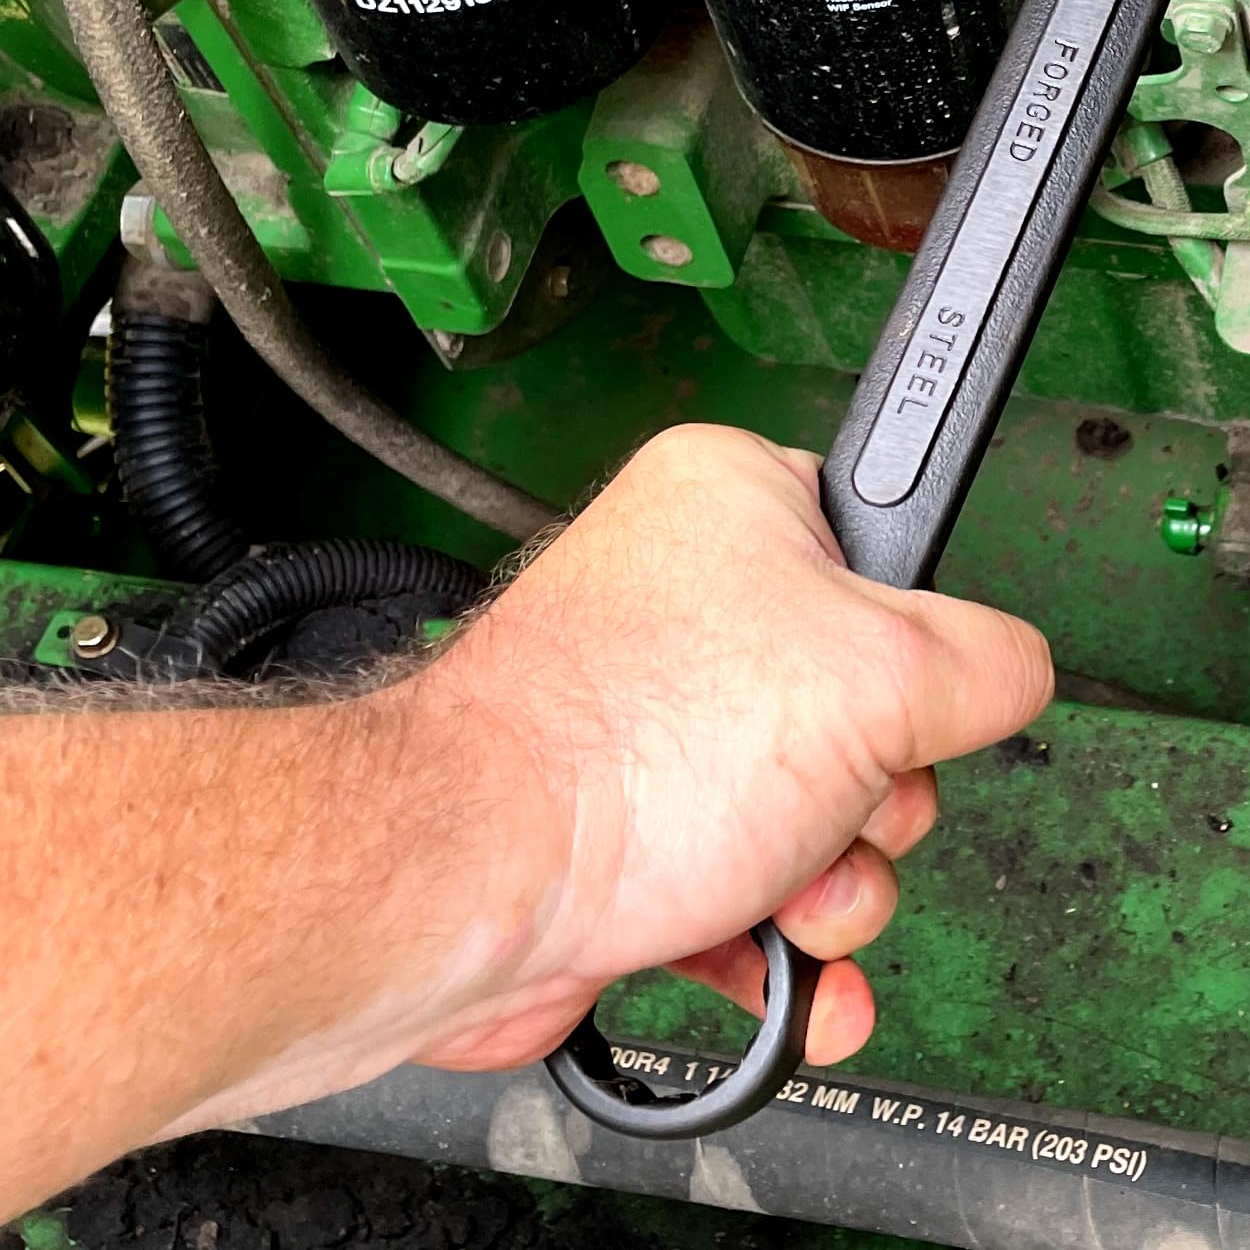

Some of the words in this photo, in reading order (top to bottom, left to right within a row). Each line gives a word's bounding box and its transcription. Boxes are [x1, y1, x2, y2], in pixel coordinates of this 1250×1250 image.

[1009, 38, 1080, 163] FORGED
[897, 306, 966, 415] STEEL
[811, 1085, 861, 1114] MM
[871, 1096, 925, 1130] W.P.
[935, 1111, 966, 1138] 14
[968, 1117, 1030, 1152] BAR
[1032, 1129, 1088, 1165] (203
[1090, 1143, 1148, 1182] PSI)
